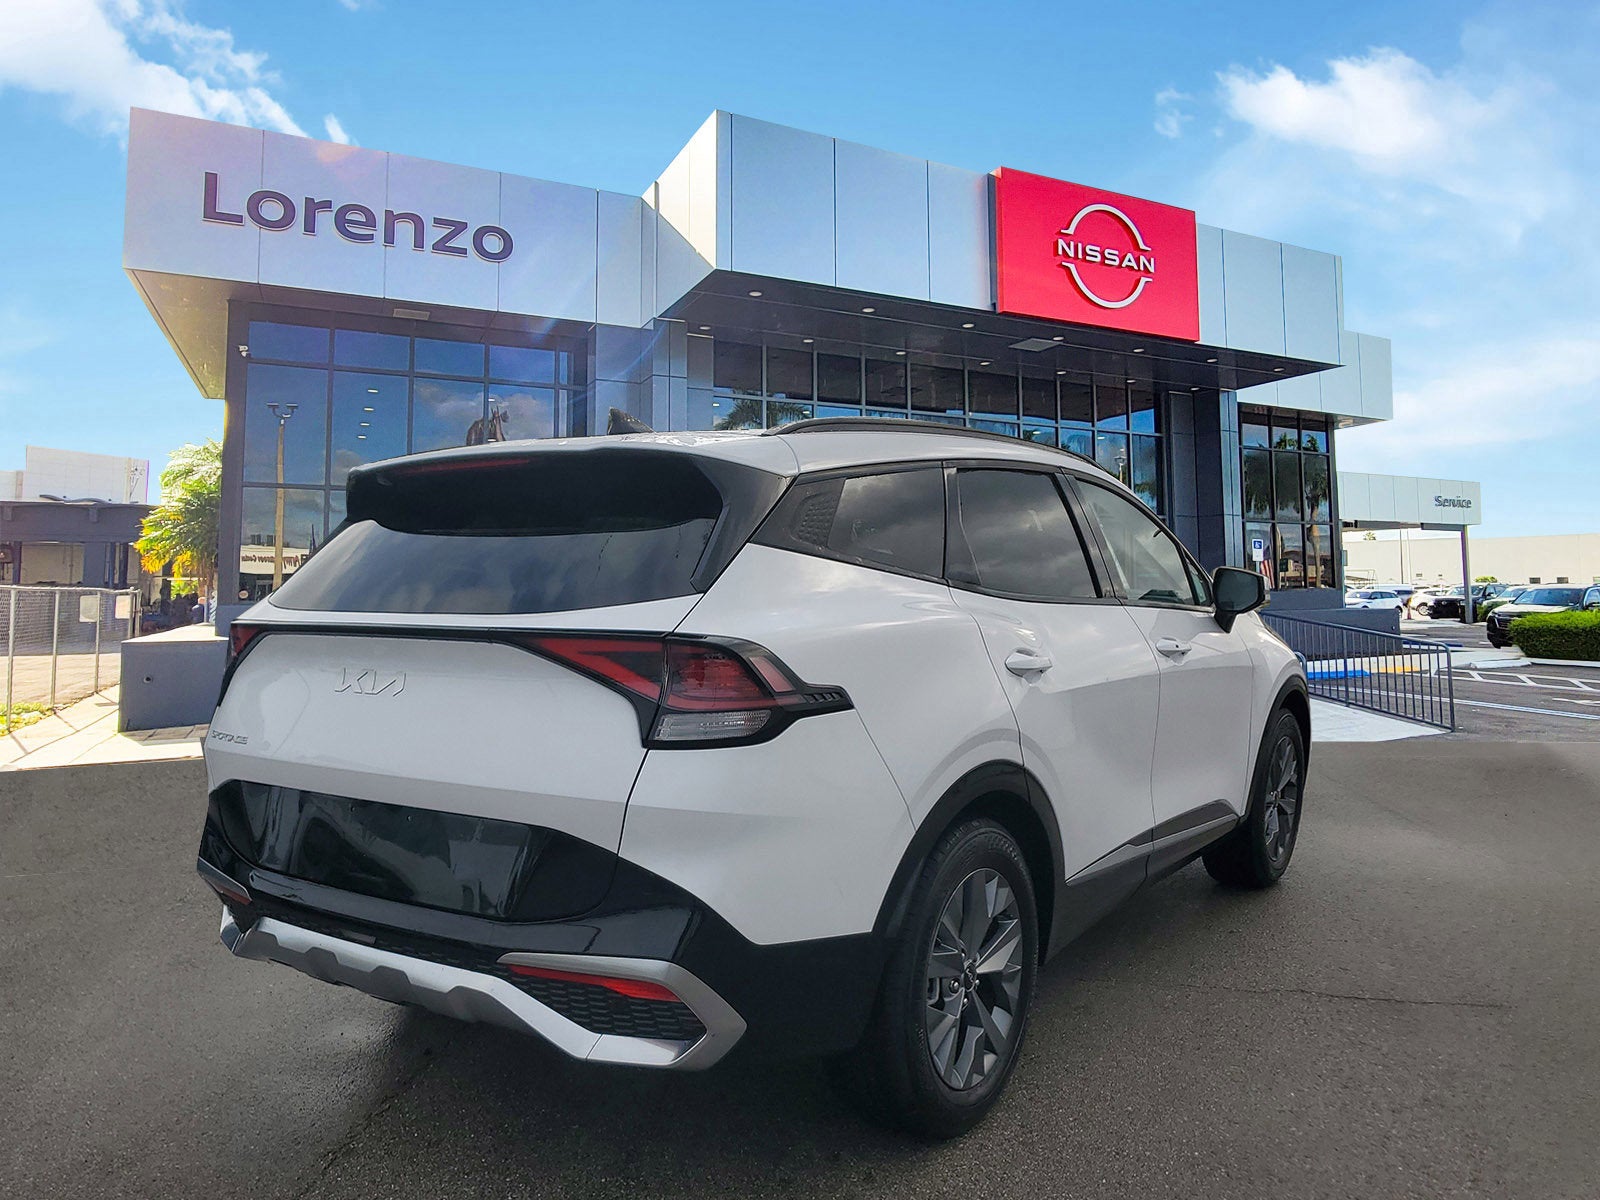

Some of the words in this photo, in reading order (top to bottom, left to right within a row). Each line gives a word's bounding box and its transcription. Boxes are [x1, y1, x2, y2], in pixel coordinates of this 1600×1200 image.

[202, 171, 515, 262] Lorenzo
[1057, 238, 1155, 273] NISSAN
[1434, 495, 1472, 509] Service
[334, 667, 407, 697] KIA
